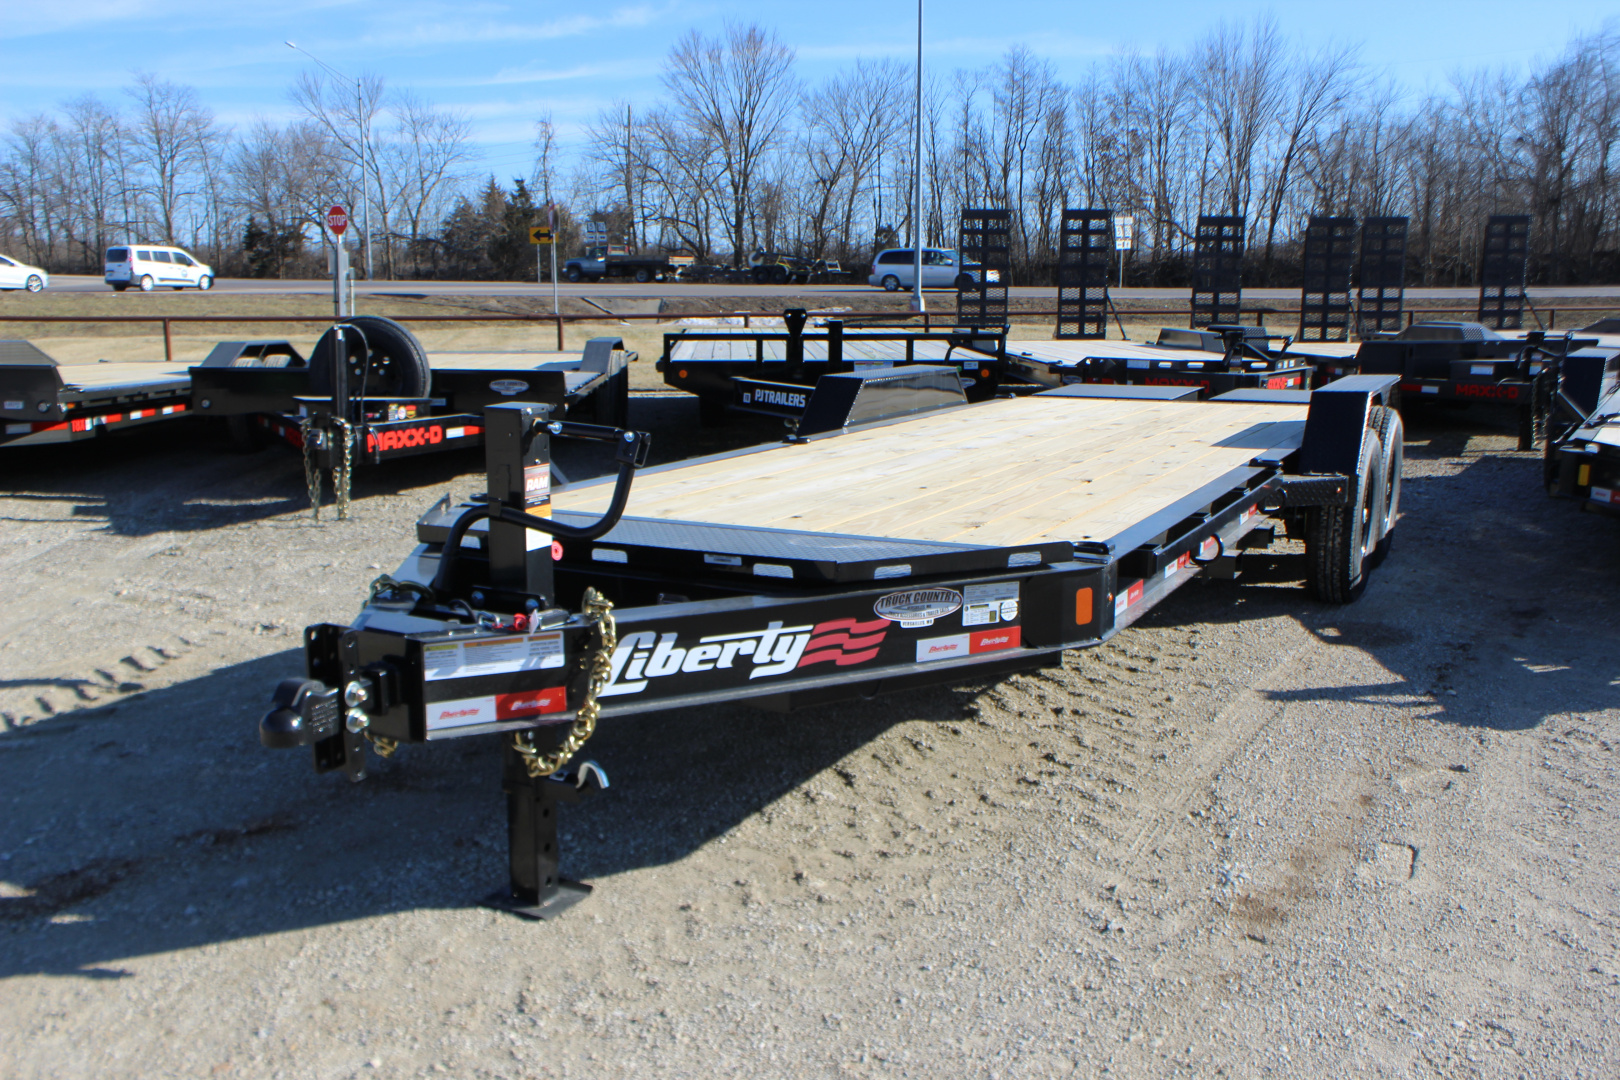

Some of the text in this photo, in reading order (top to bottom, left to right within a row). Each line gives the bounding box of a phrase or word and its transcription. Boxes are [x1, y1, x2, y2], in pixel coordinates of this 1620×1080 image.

[328, 215, 346, 226] STOP
[526, 476, 549, 492] RAM
[879, 594, 912, 609] TRUCK
[914, 591, 958, 603] COUNTRY
[596, 621, 814, 697] Liberty
